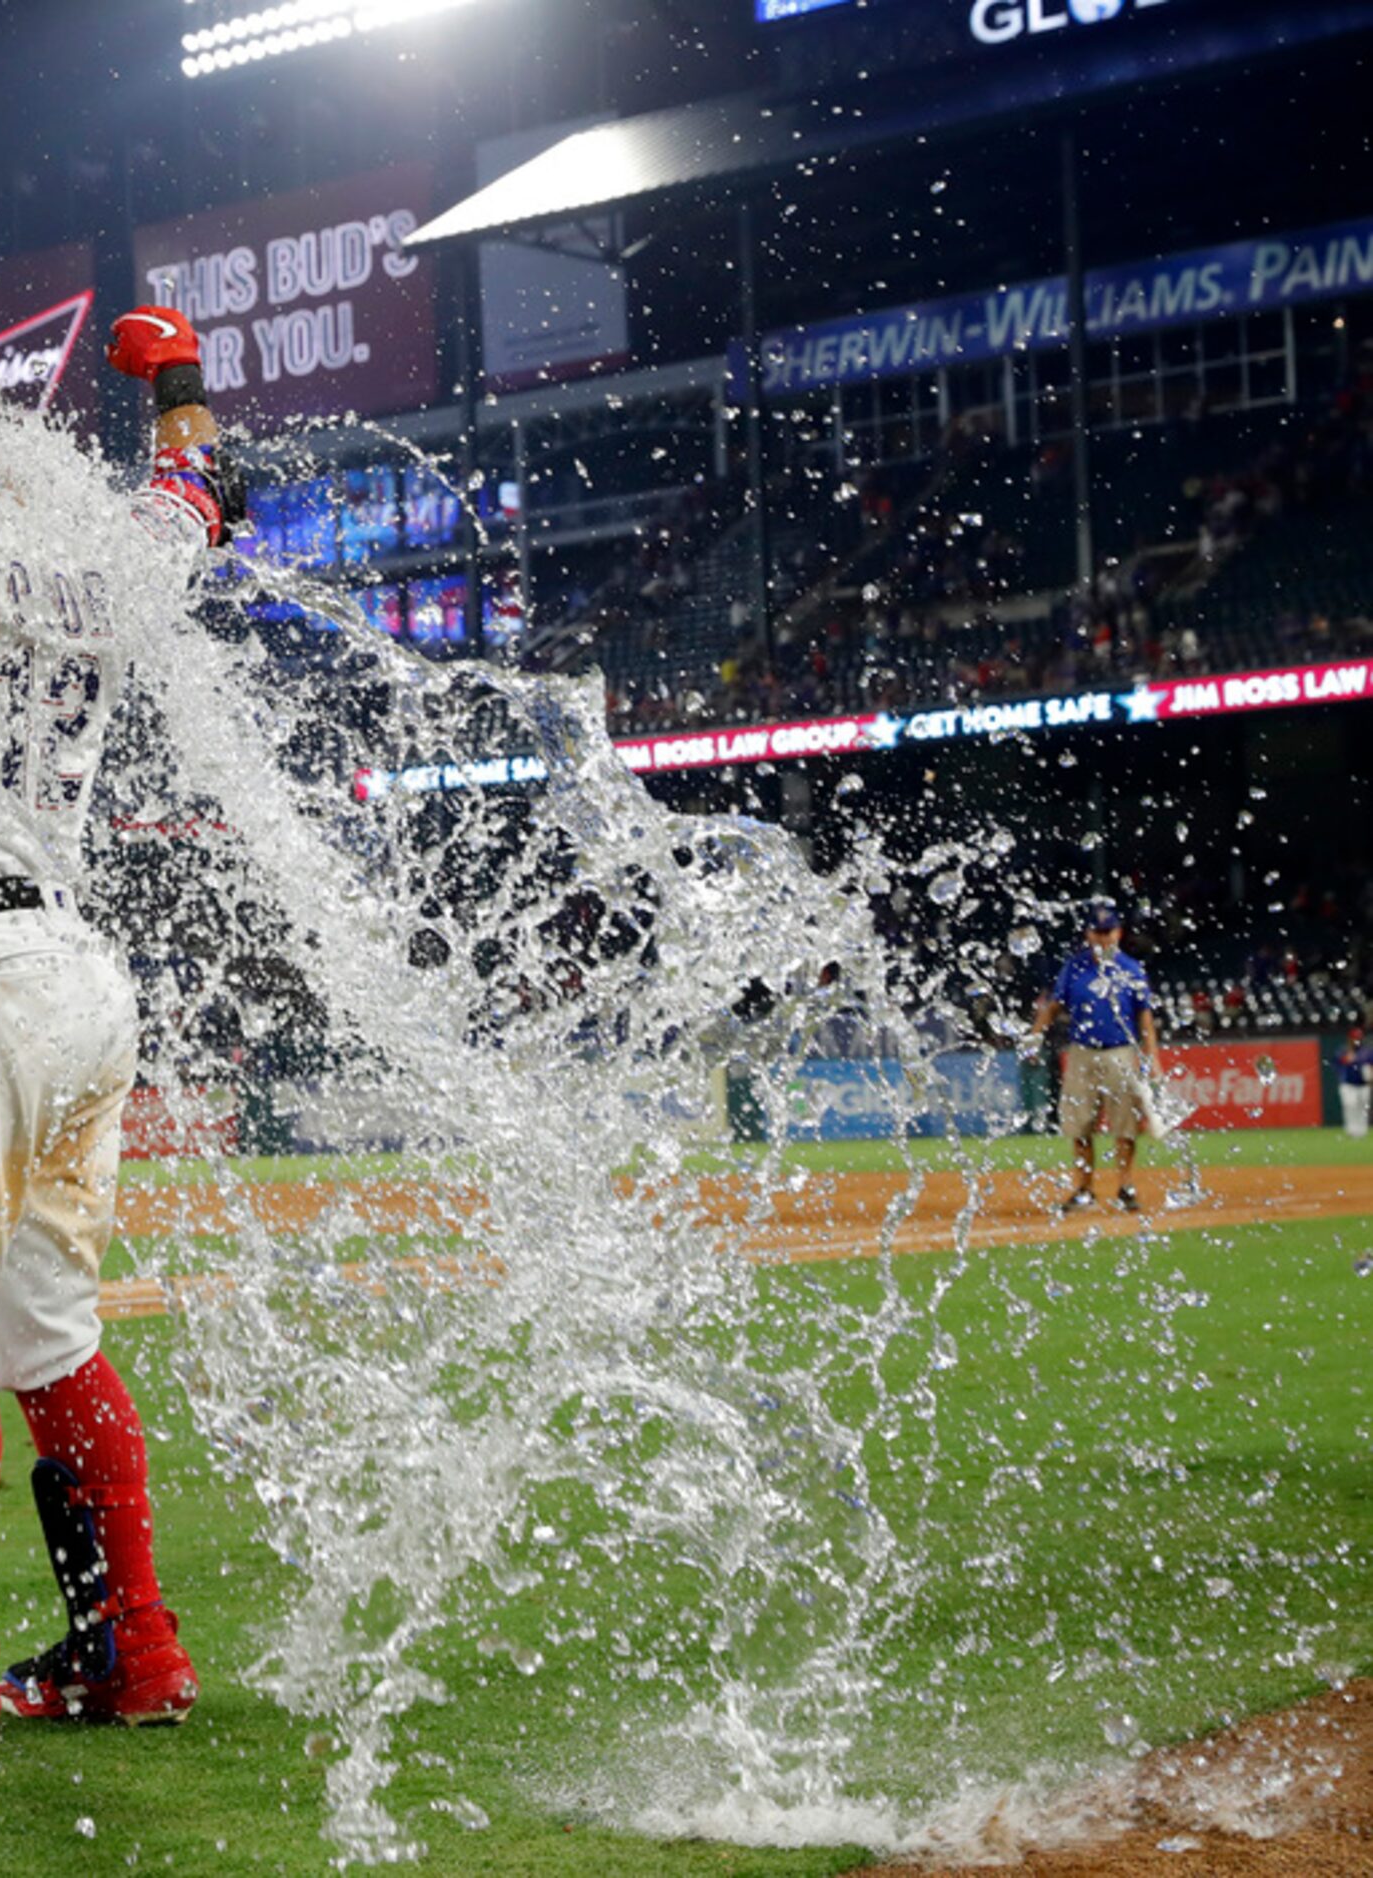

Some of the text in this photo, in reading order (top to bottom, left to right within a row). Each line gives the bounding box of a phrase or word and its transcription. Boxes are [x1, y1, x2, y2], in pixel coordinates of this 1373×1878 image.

[146, 208, 419, 322] THIS BUD'S
[252, 301, 370, 383] YOU.
[615, 665, 1367, 770] IM ROSS LAW GROUP GET HOME SAFE JIM ROSS LAW
